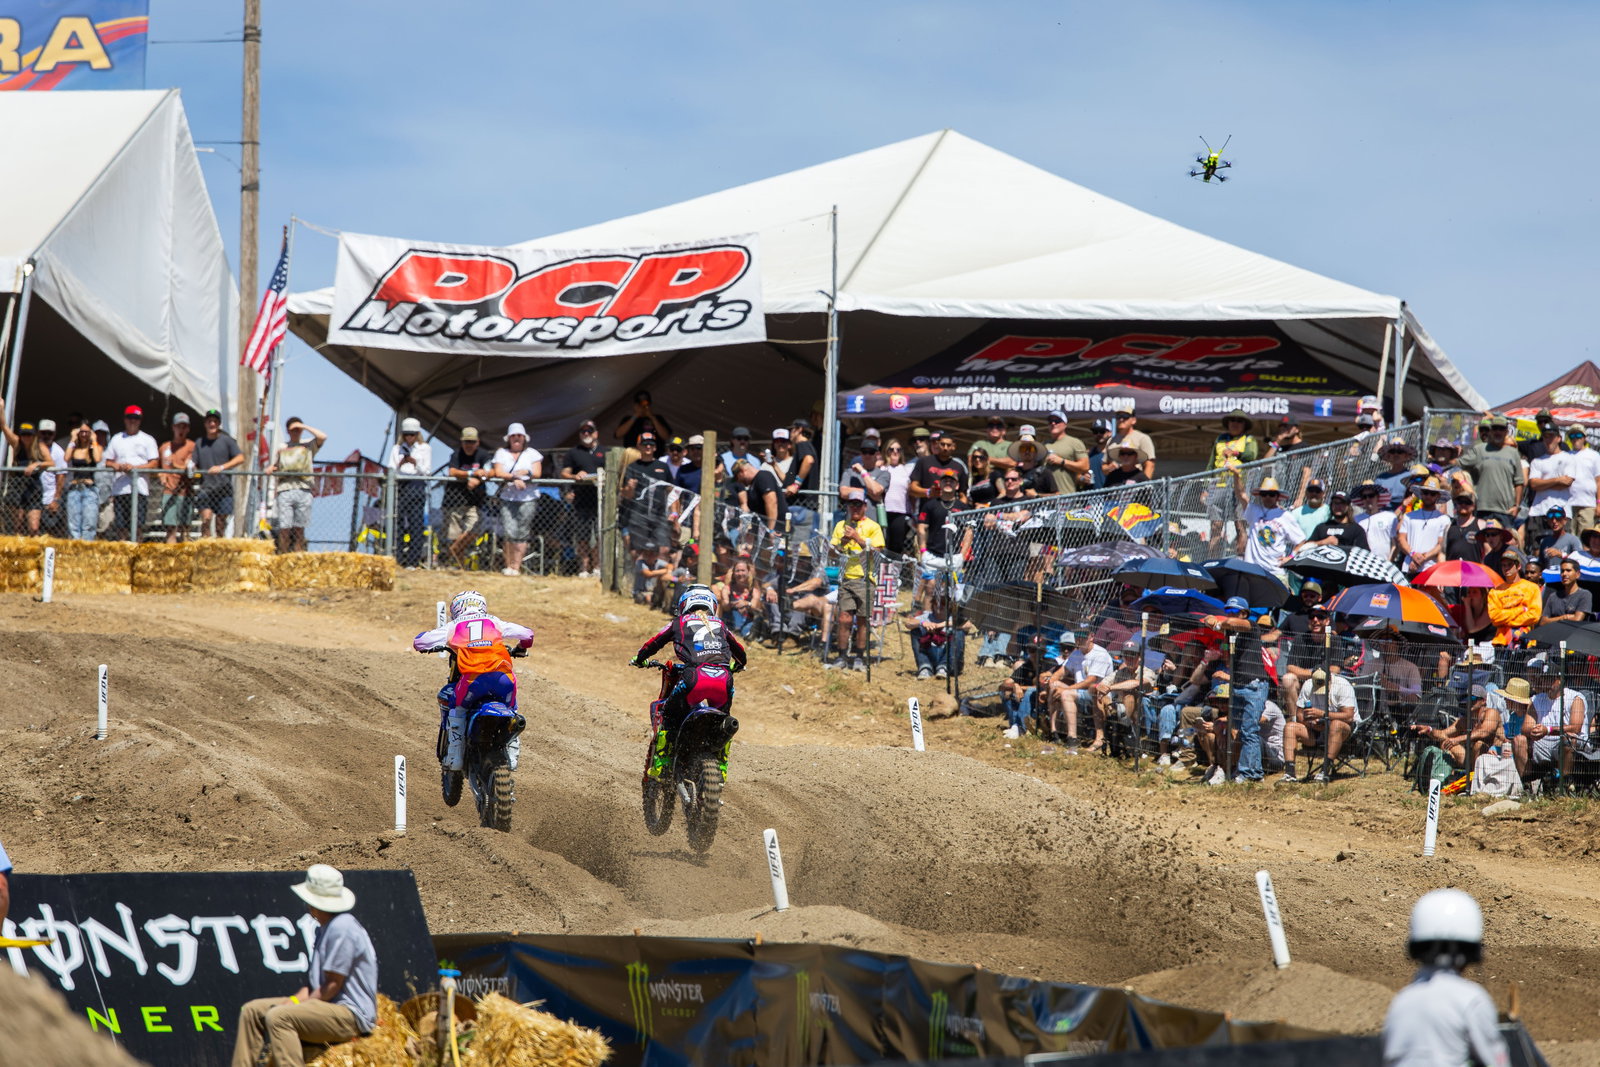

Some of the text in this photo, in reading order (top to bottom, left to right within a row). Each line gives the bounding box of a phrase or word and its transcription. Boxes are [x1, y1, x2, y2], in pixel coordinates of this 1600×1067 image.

[366, 245, 751, 322] PCP
[343, 299, 750, 347] Motorsports
[962, 334, 1281, 362] PCP
[955, 356, 1284, 373] Motorsports
[930, 374, 996, 386] YAMAHA
[1132, 368, 1225, 384] HONDA
[1258, 373, 1329, 384] SUZUKI
[466, 619, 484, 642] 1
[686, 620, 722, 642] 7
[696, 649, 722, 657] HONDA
[648, 978, 705, 1004] MONSTER
